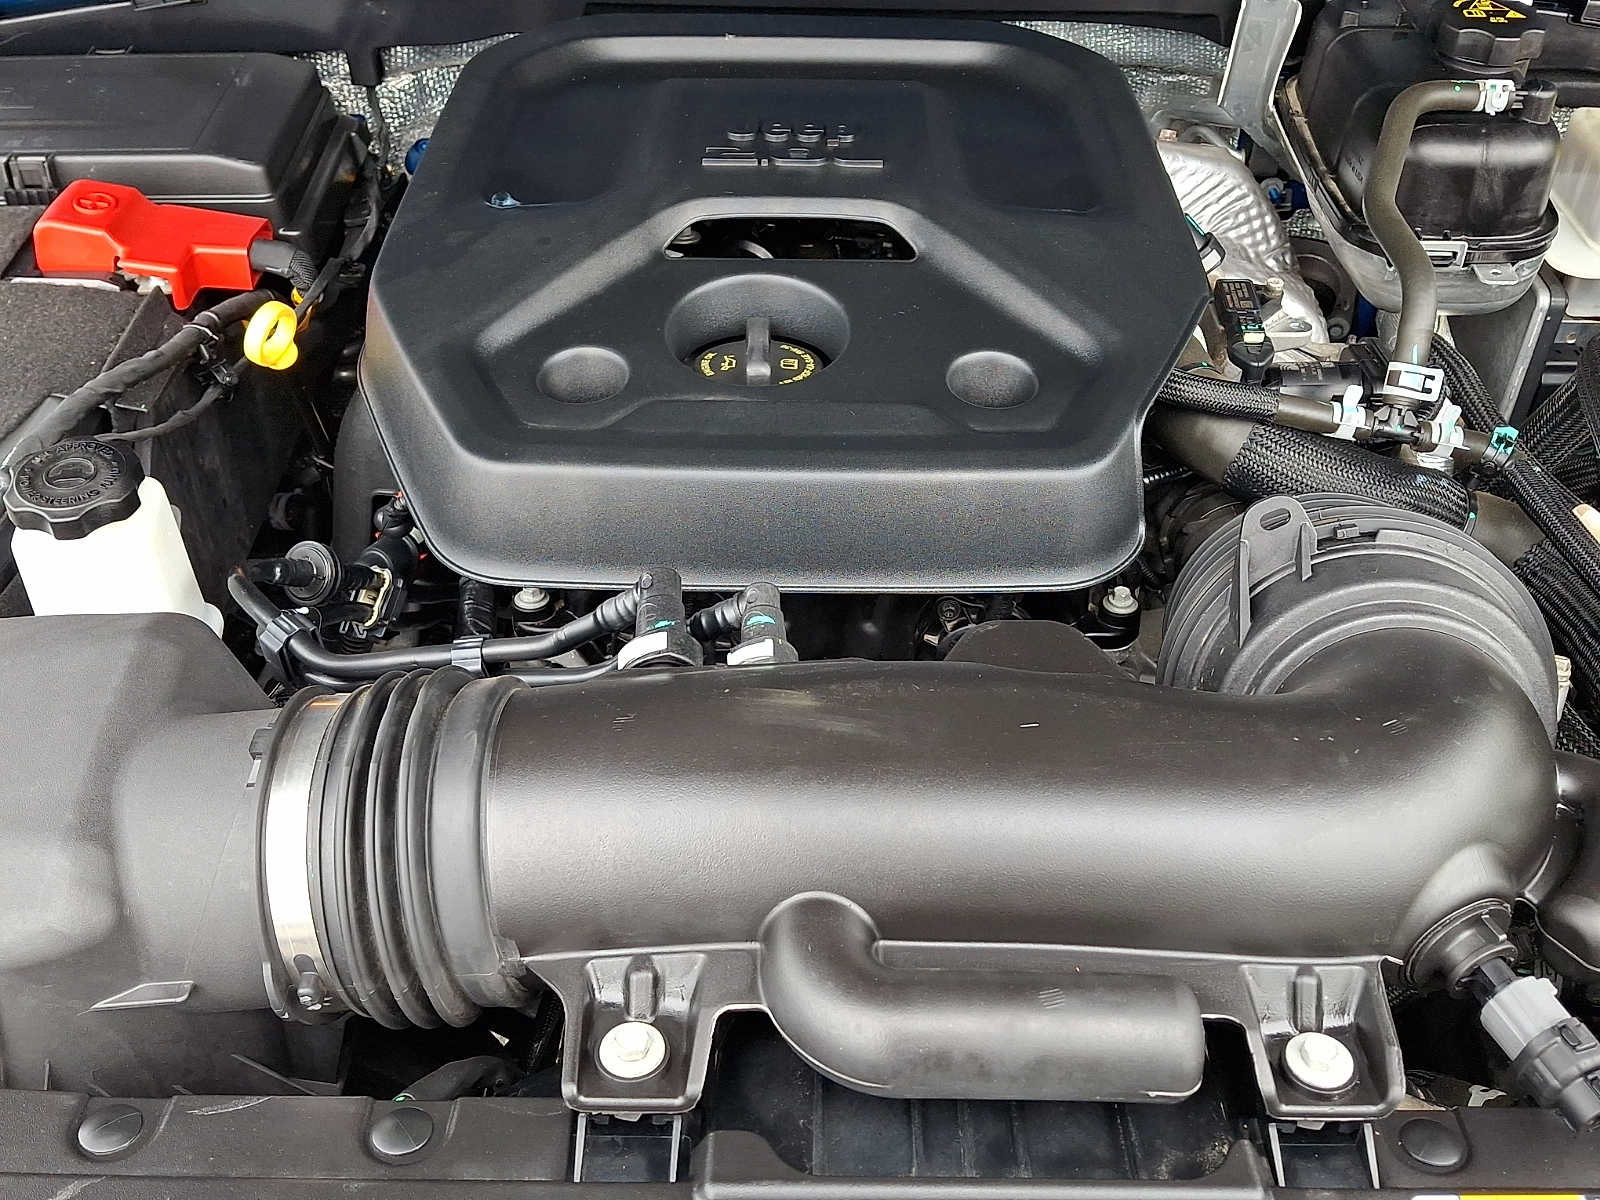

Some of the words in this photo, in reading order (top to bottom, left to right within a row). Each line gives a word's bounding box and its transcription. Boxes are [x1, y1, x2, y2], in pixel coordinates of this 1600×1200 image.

[727, 121, 856, 147] Jeep
[56, 441, 115, 459] APPROVED
[39, 488, 101, 505] STEERING
